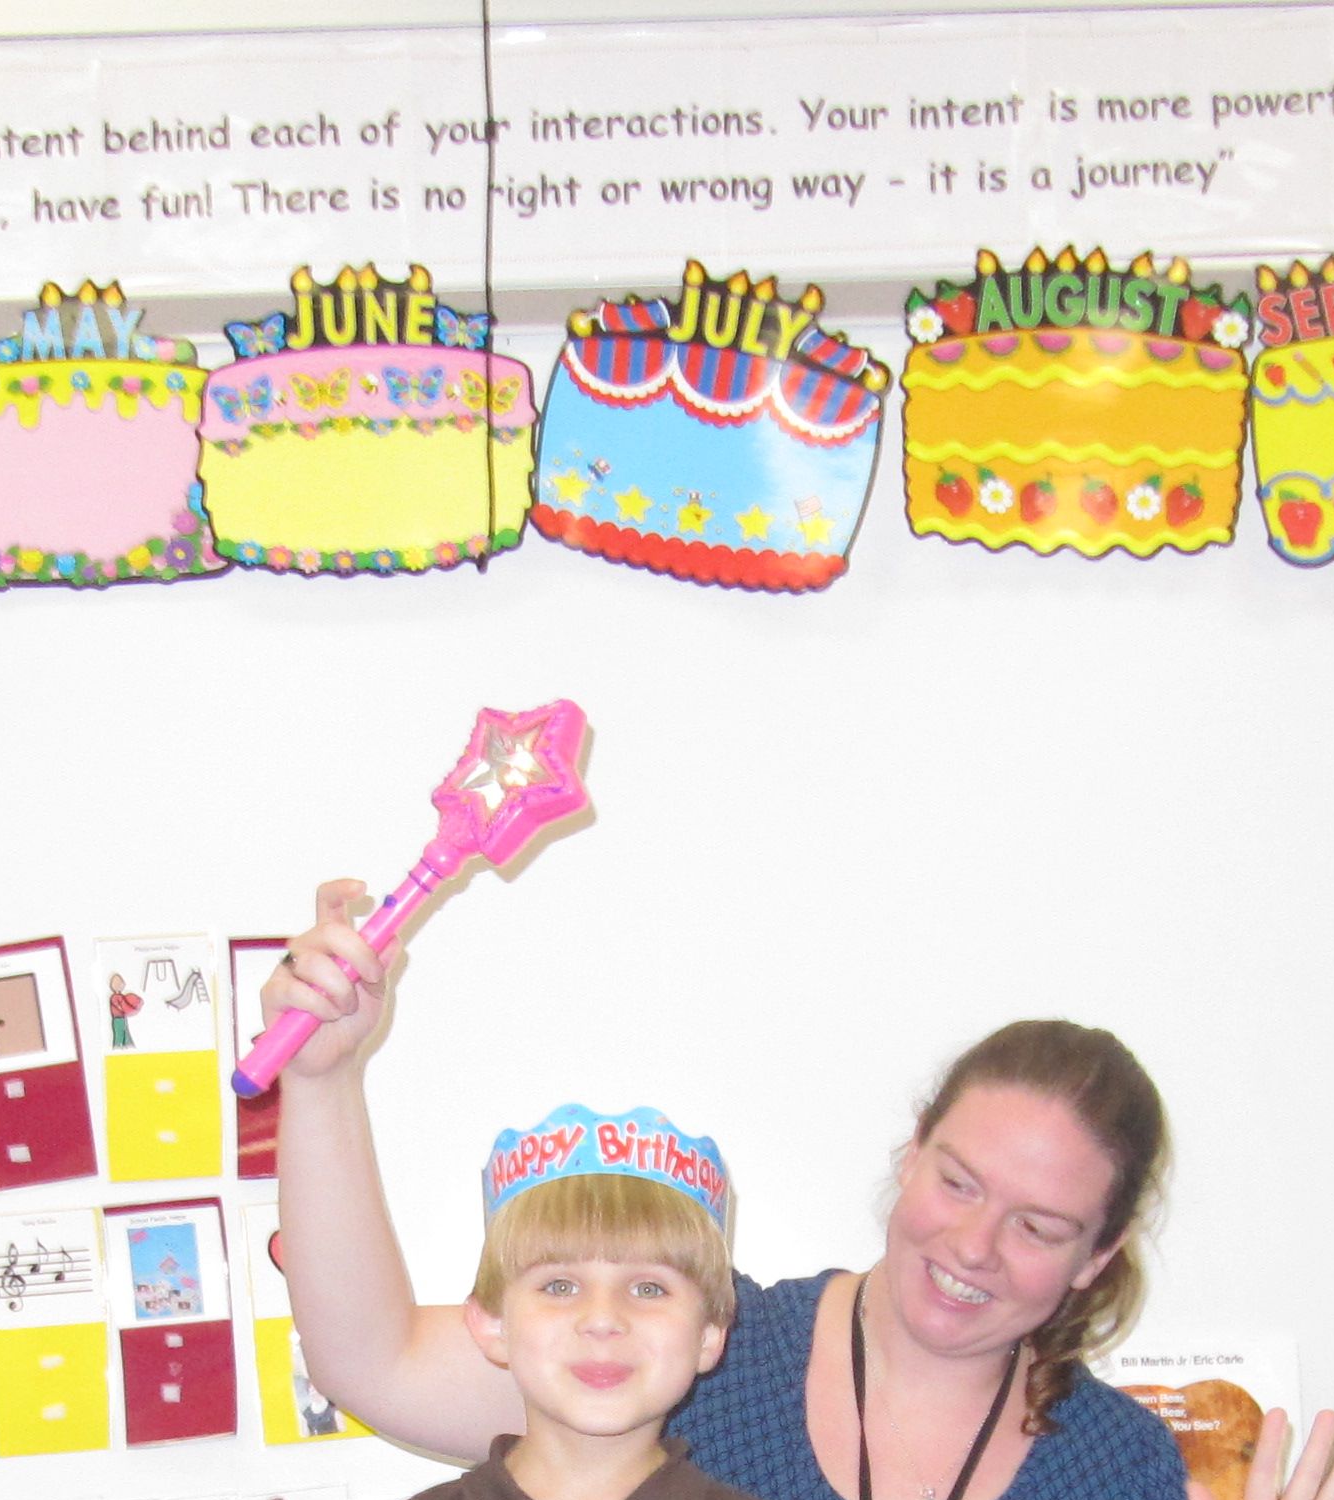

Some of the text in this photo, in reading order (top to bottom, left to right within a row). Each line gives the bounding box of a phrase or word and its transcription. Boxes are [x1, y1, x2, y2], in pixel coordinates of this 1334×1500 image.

[102, 114, 230, 154] behind
[250, 112, 340, 148] each
[359, 109, 400, 147] of
[425, 116, 511, 157] your
[531, 104, 776, 142] interactions.
[799, 98, 889, 132] Your
[910, 94, 1024, 129] intent
[1049, 91, 1078, 123] is
[1097, 93, 1192, 122] more
[32, 188, 121, 223] have
[140, 182, 212, 221] fun!
[231, 179, 349, 214] There
[371, 178, 399, 211] is
[424, 186, 466, 211] no
[601, 179, 641, 205] or
[660, 175, 773, 211] wrong
[792, 171, 866, 208] way
[930, 162, 957, 194] it
[978, 160, 1008, 192] is
[1031, 166, 1052, 190] a
[22, 307, 144, 361] MAY
[287, 290, 434, 349] JUNE
[668, 286, 809, 357] JULY
[976, 275, 1190, 335] AUGUST
[490, 1122, 725, 1204] Happy Birthday
[1121, 1357, 1138, 1367] Bill
[1141, 1356, 1174, 1367] Martin
[1177, 1356, 1187, 1367] Jr
[1194, 1355, 1214, 1365] Eric
[1216, 1354, 1244, 1364] Carle
[1173, 1420, 1220, 1432] You See?
